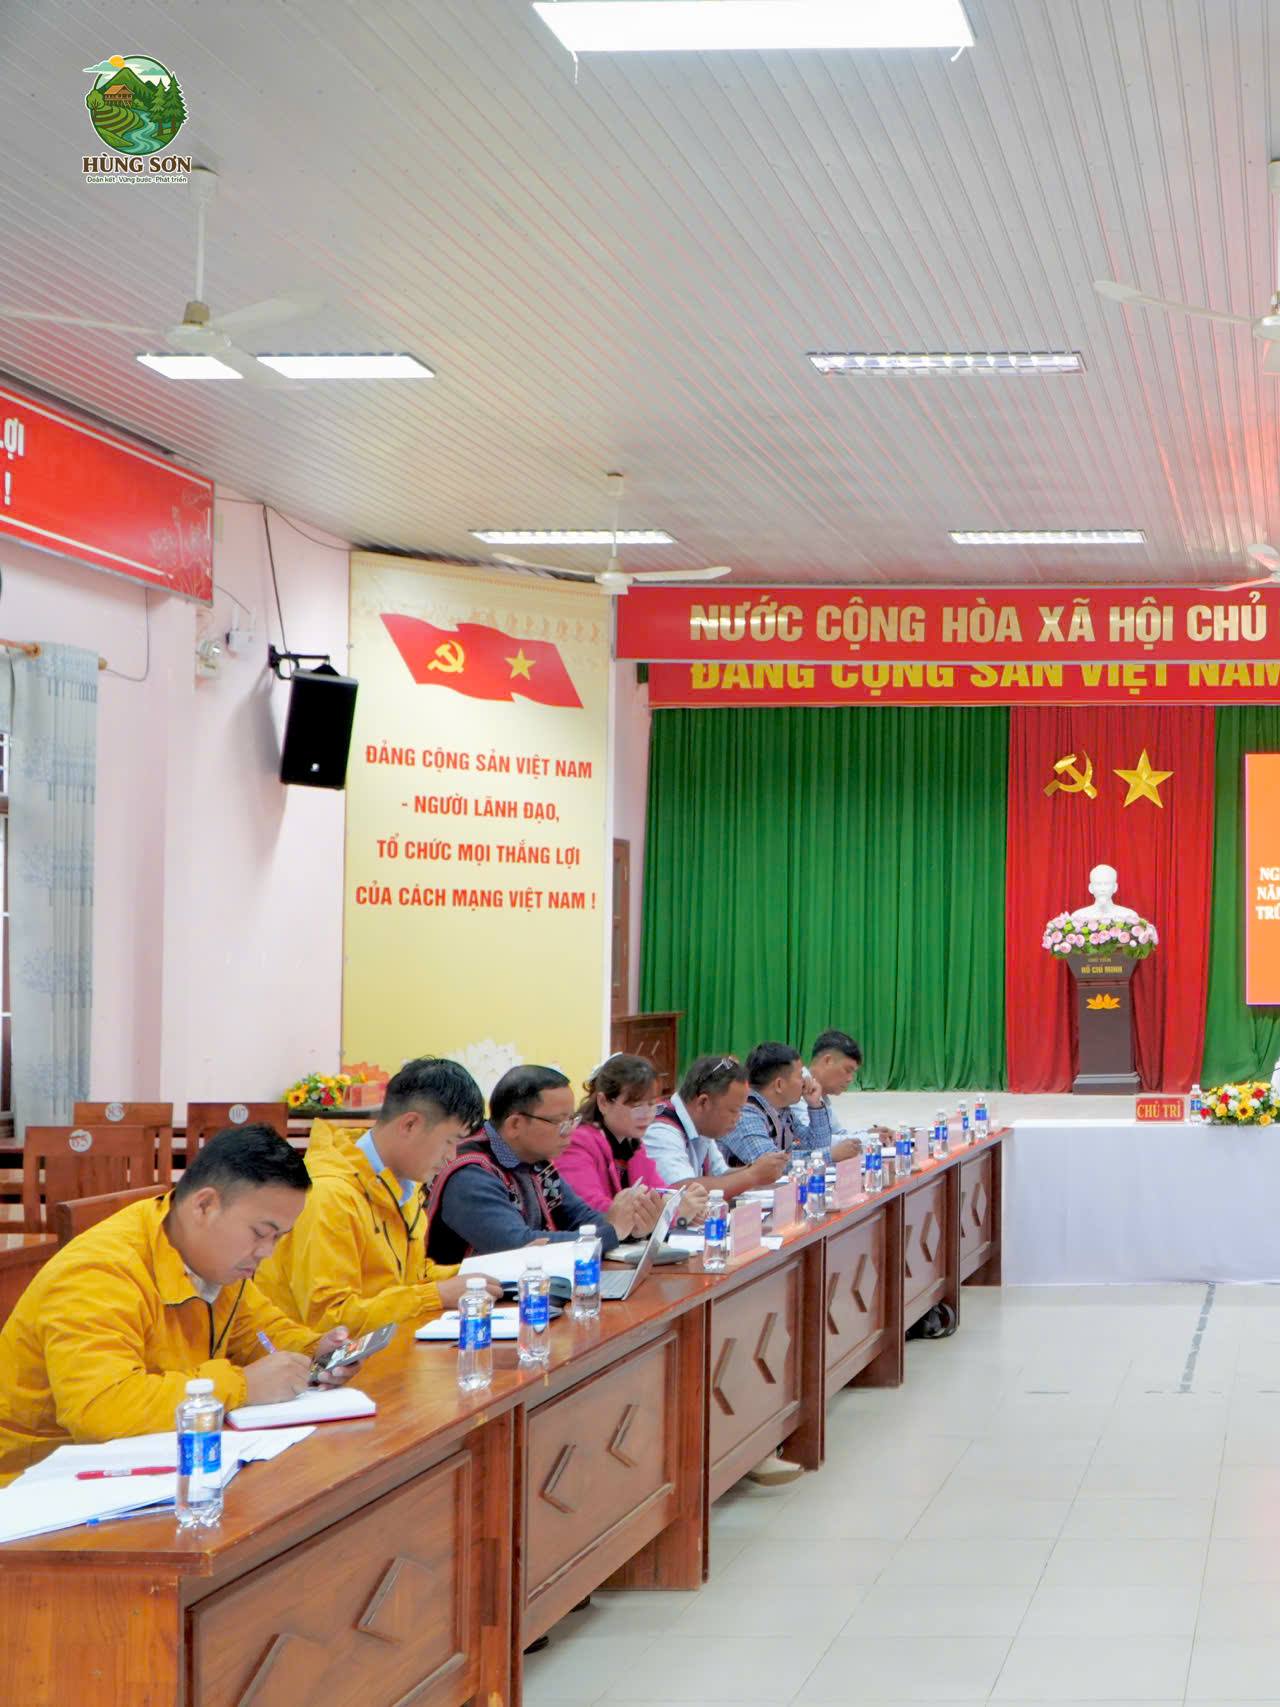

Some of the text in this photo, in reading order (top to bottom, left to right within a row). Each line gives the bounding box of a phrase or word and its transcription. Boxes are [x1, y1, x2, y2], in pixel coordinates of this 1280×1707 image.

[0, 418, 24, 459] ỢI
[4, 472, 11, 505] !
[690, 597, 803, 642] NƯỚC
[817, 597, 924, 651] CỘNG
[943, 597, 1022, 643] HÒA
[1038, 597, 1096, 643] XÃ
[1110, 596, 1172, 651] HỘI
[1187, 592, 1267, 643] CHỦ
[366, 741, 592, 779] ĐẢNG CỘNG SẢN VIỆT NAM
[414, 793, 468, 816] NGƯỜI
[474, 796, 517, 818] LÃNH
[523, 801, 560, 823] ĐẠO,
[377, 833, 580, 869] TỔ CHỨC MỌI THẮNG LỢI
[356, 880, 596, 913] CỦA CÁCH MẠNG VIỆT NAM !
[1137, 1102, 1160, 1118] CHỦ
[1163, 1101, 1180, 1118] TRÌ
